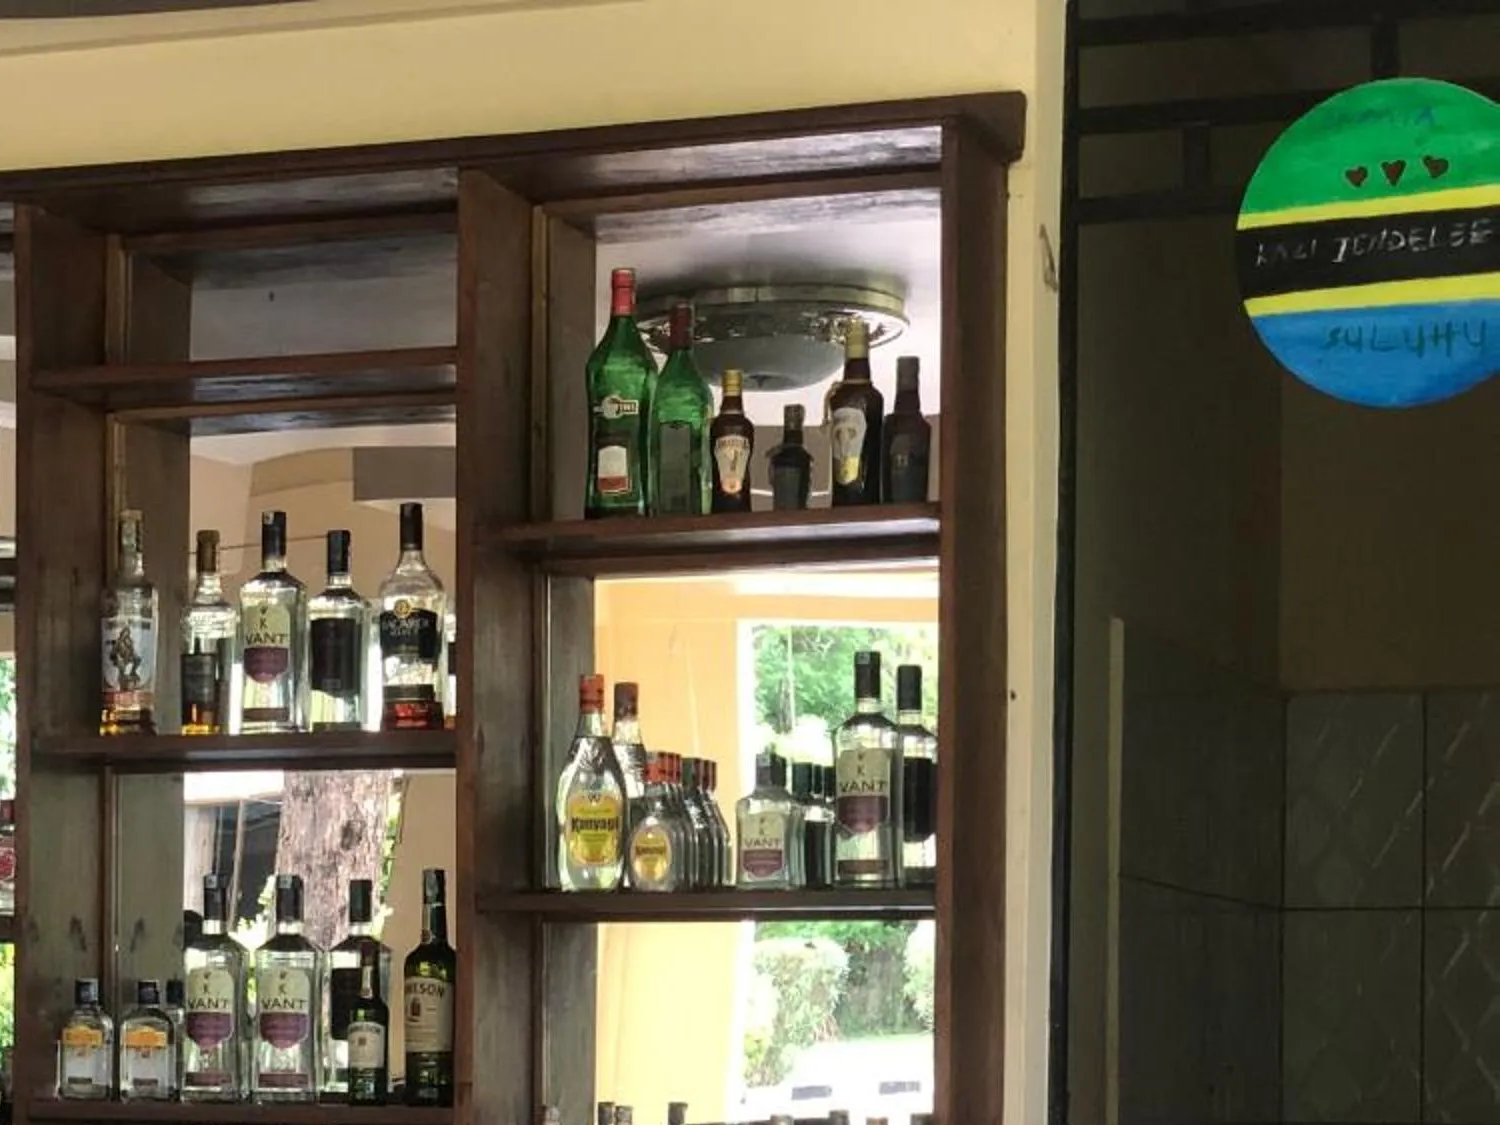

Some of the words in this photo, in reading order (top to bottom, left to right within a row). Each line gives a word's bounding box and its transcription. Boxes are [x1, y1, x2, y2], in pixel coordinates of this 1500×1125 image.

[245, 632, 288, 644] VANT
[840, 781, 886, 793] VANT
[188, 997, 230, 1009] VANT
[261, 998, 309, 1010] VANT
